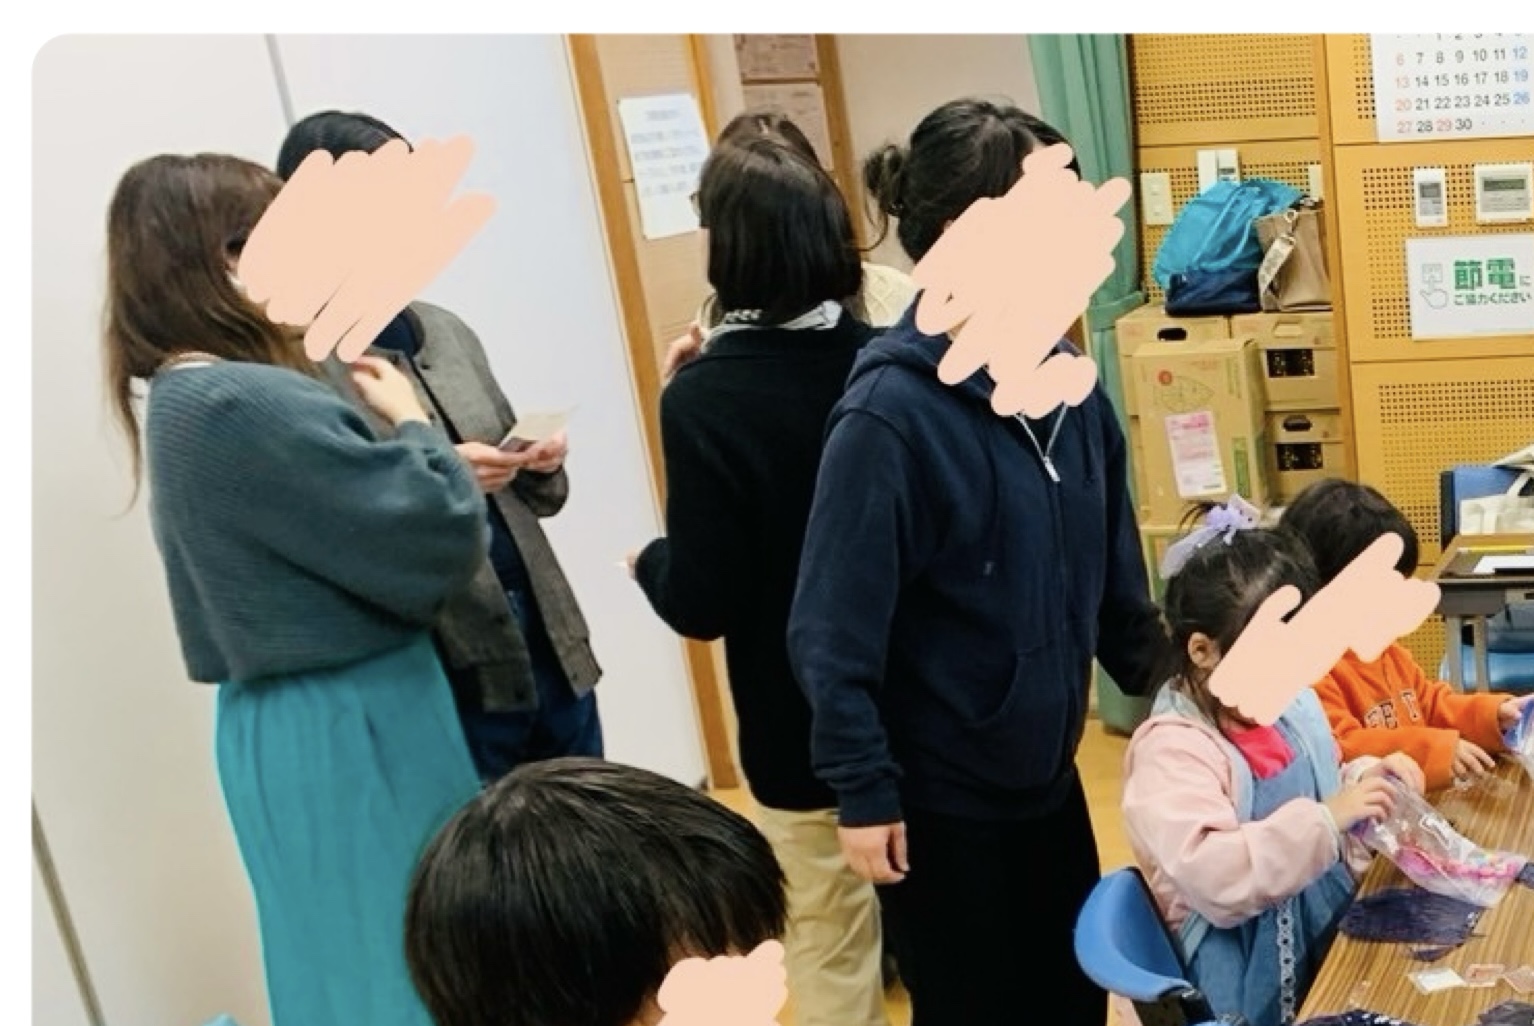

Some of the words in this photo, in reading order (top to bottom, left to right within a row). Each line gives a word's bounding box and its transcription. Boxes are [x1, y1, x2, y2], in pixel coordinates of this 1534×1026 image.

[1416, 53, 1424, 64] 7
[1437, 51, 1443, 64] 8
[1456, 50, 1464, 63] 9
[1474, 50, 1486, 62] 10
[1494, 49, 1506, 60] 11
[1513, 47, 1527, 59] 12
[1416, 76, 1429, 87] 14
[1435, 74, 1449, 86] 15
[1455, 73, 1468, 85] 16
[1474, 72, 1487, 84] 17
[1494, 72, 1508, 83] 18
[1514, 71, 1528, 82] 19
[1416, 99, 1430, 110] 21
[1435, 98, 1450, 109] 22
[1455, 96, 1470, 108] 23
[1474, 95, 1490, 107] 24
[1494, 94, 1509, 106] 25
[1514, 93, 1529, 104] 26
[1417, 121, 1432, 132] 28
[1437, 120, 1451, 131] 29
[1455, 118, 1472, 130] 30
